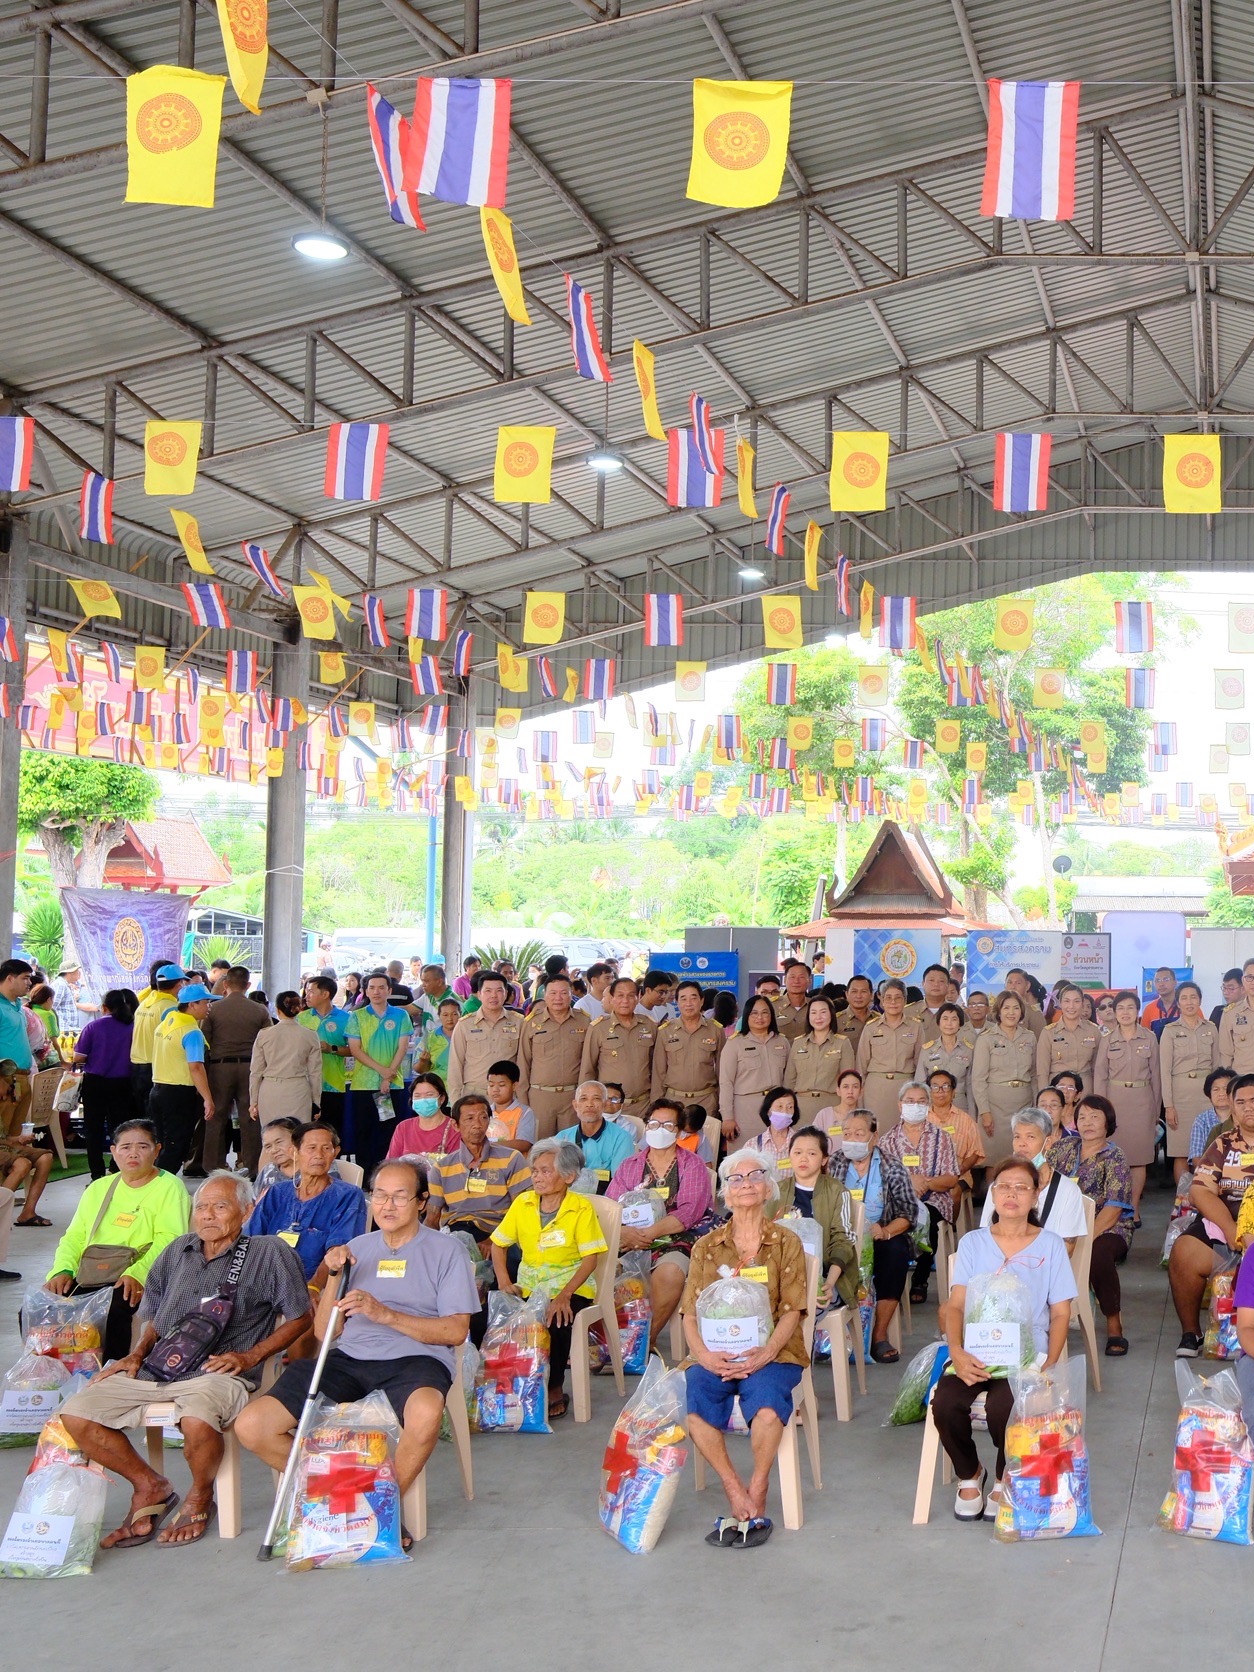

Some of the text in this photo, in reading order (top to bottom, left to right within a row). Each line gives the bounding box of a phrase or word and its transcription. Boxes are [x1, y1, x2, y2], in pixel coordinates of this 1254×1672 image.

[994, 943, 1051, 955] สมุทรสงคราม
[1073, 953, 1104, 964] ส่วนหน้า
[1223, 1149, 1242, 1167] 99
